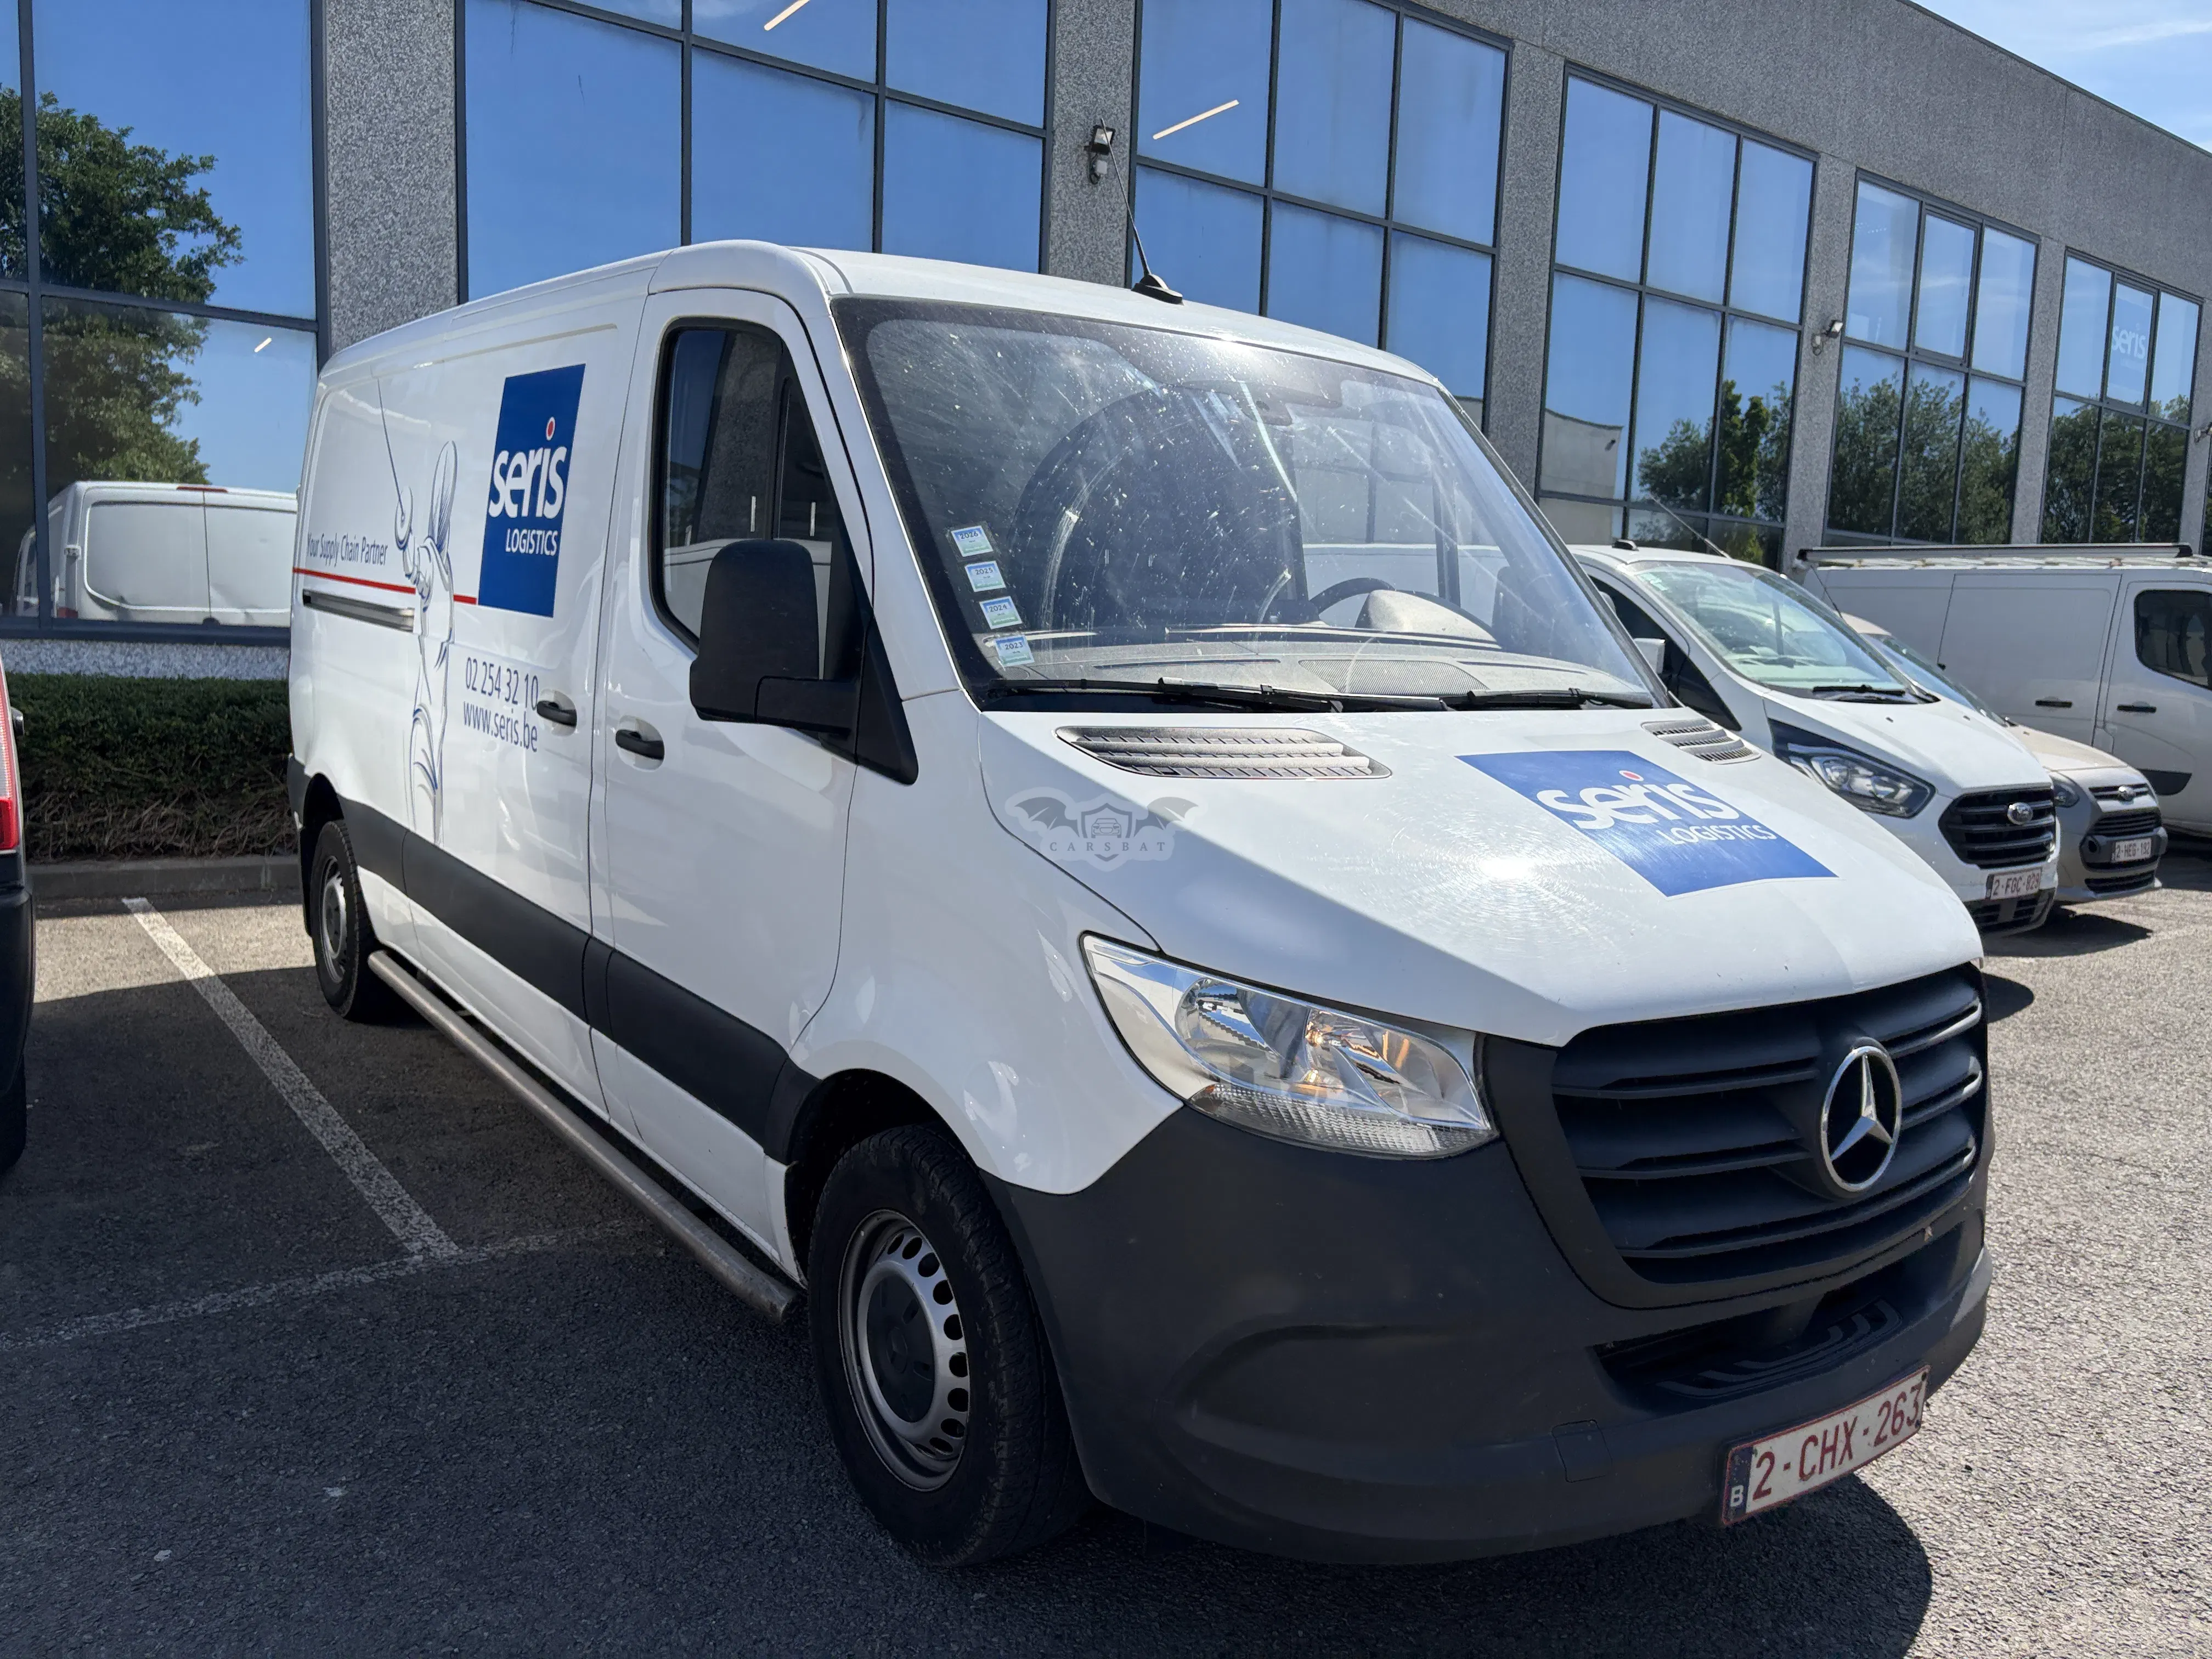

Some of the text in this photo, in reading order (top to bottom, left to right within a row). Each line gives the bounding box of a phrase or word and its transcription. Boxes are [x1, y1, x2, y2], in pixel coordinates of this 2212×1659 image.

[2112, 323, 2147, 359] seris
[488, 416, 567, 518] seris
[505, 528, 558, 556] LOGISTICS
[960, 531, 979, 539] 2026
[307, 532, 388, 568] Your Supply Chain Partner
[975, 567, 994, 575] 2025
[989, 604, 1007, 612] 2024
[1005, 642, 1023, 650] 2023
[466, 657, 539, 711] 02 254 32 10
[464, 701, 538, 753] www.seris.be
[1536, 769, 1740, 830] seris
[1657, 825, 1777, 845] LOGISTICS
[1730, 1485, 1744, 1508] B
